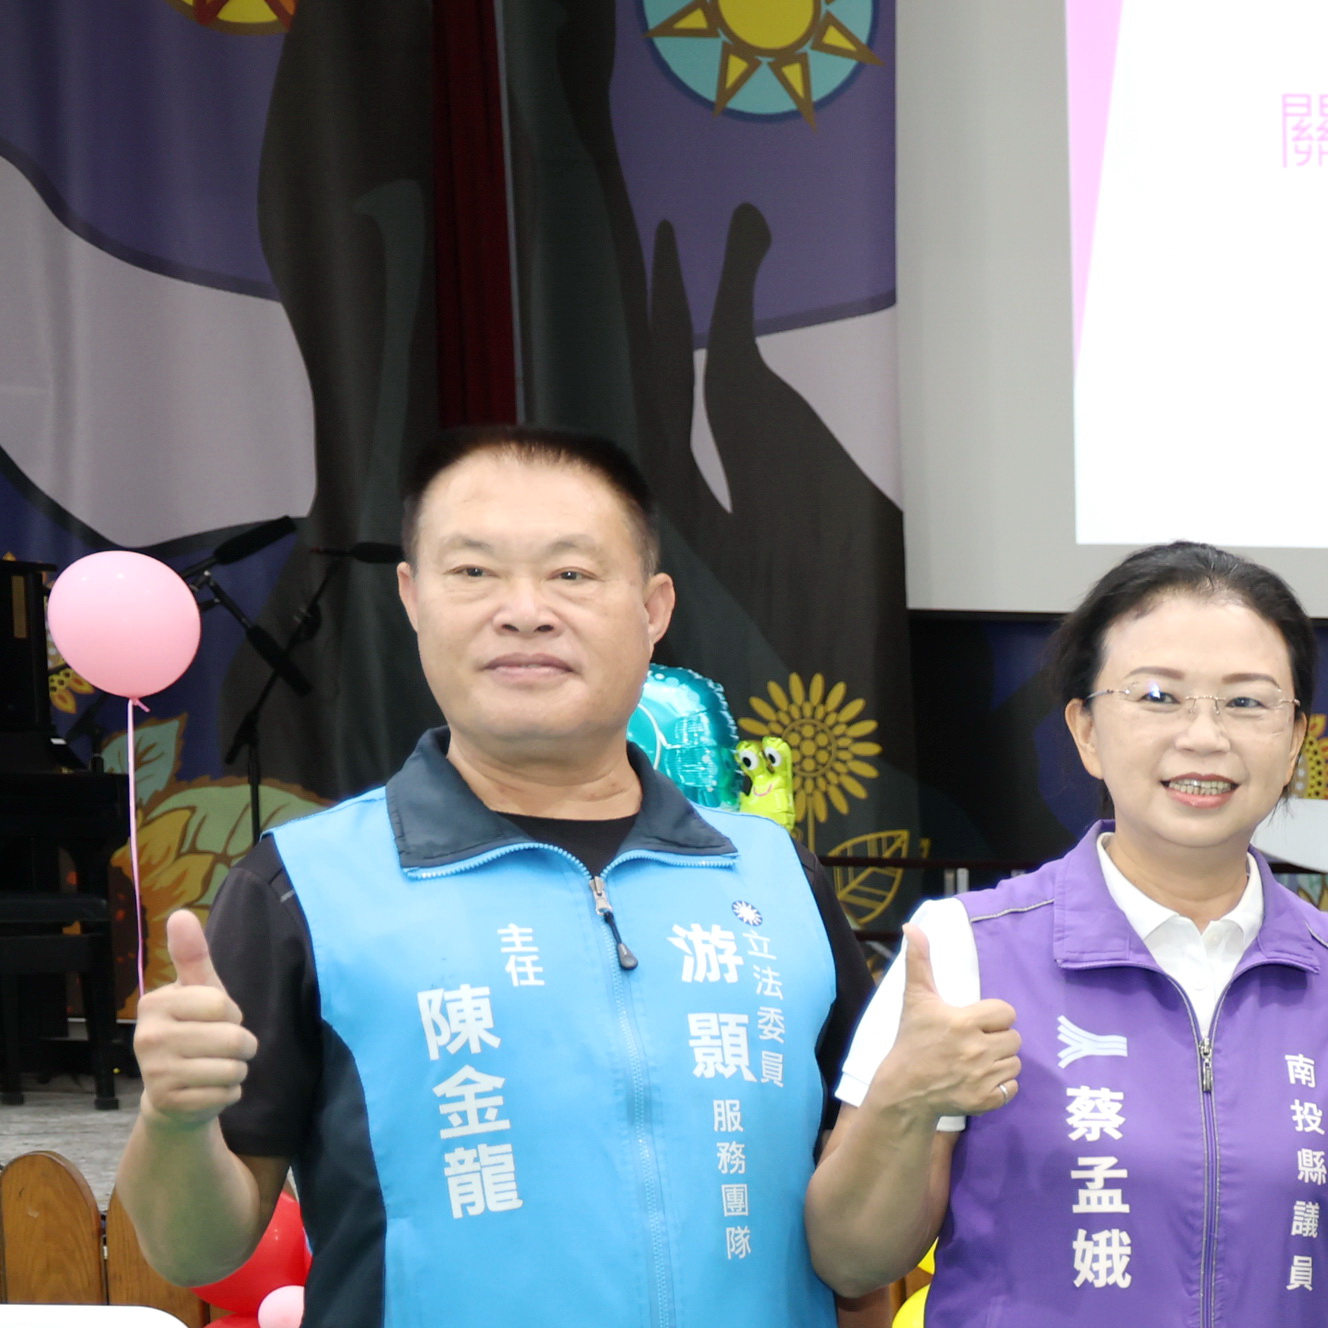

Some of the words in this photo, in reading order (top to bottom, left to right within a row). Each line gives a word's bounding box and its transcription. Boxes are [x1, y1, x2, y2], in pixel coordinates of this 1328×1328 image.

[497, 923, 545, 987] 主任
[668, 923, 758, 1083] 游顥
[743, 929, 784, 1089] 立法委員
[417, 984, 524, 1219] 陳金龍
[712, 1099, 752, 1260] 服務團隊
[1284, 1053, 1327, 1292] 南投縣議員
[1066, 1086, 1132, 1290] 蔡孟娥
